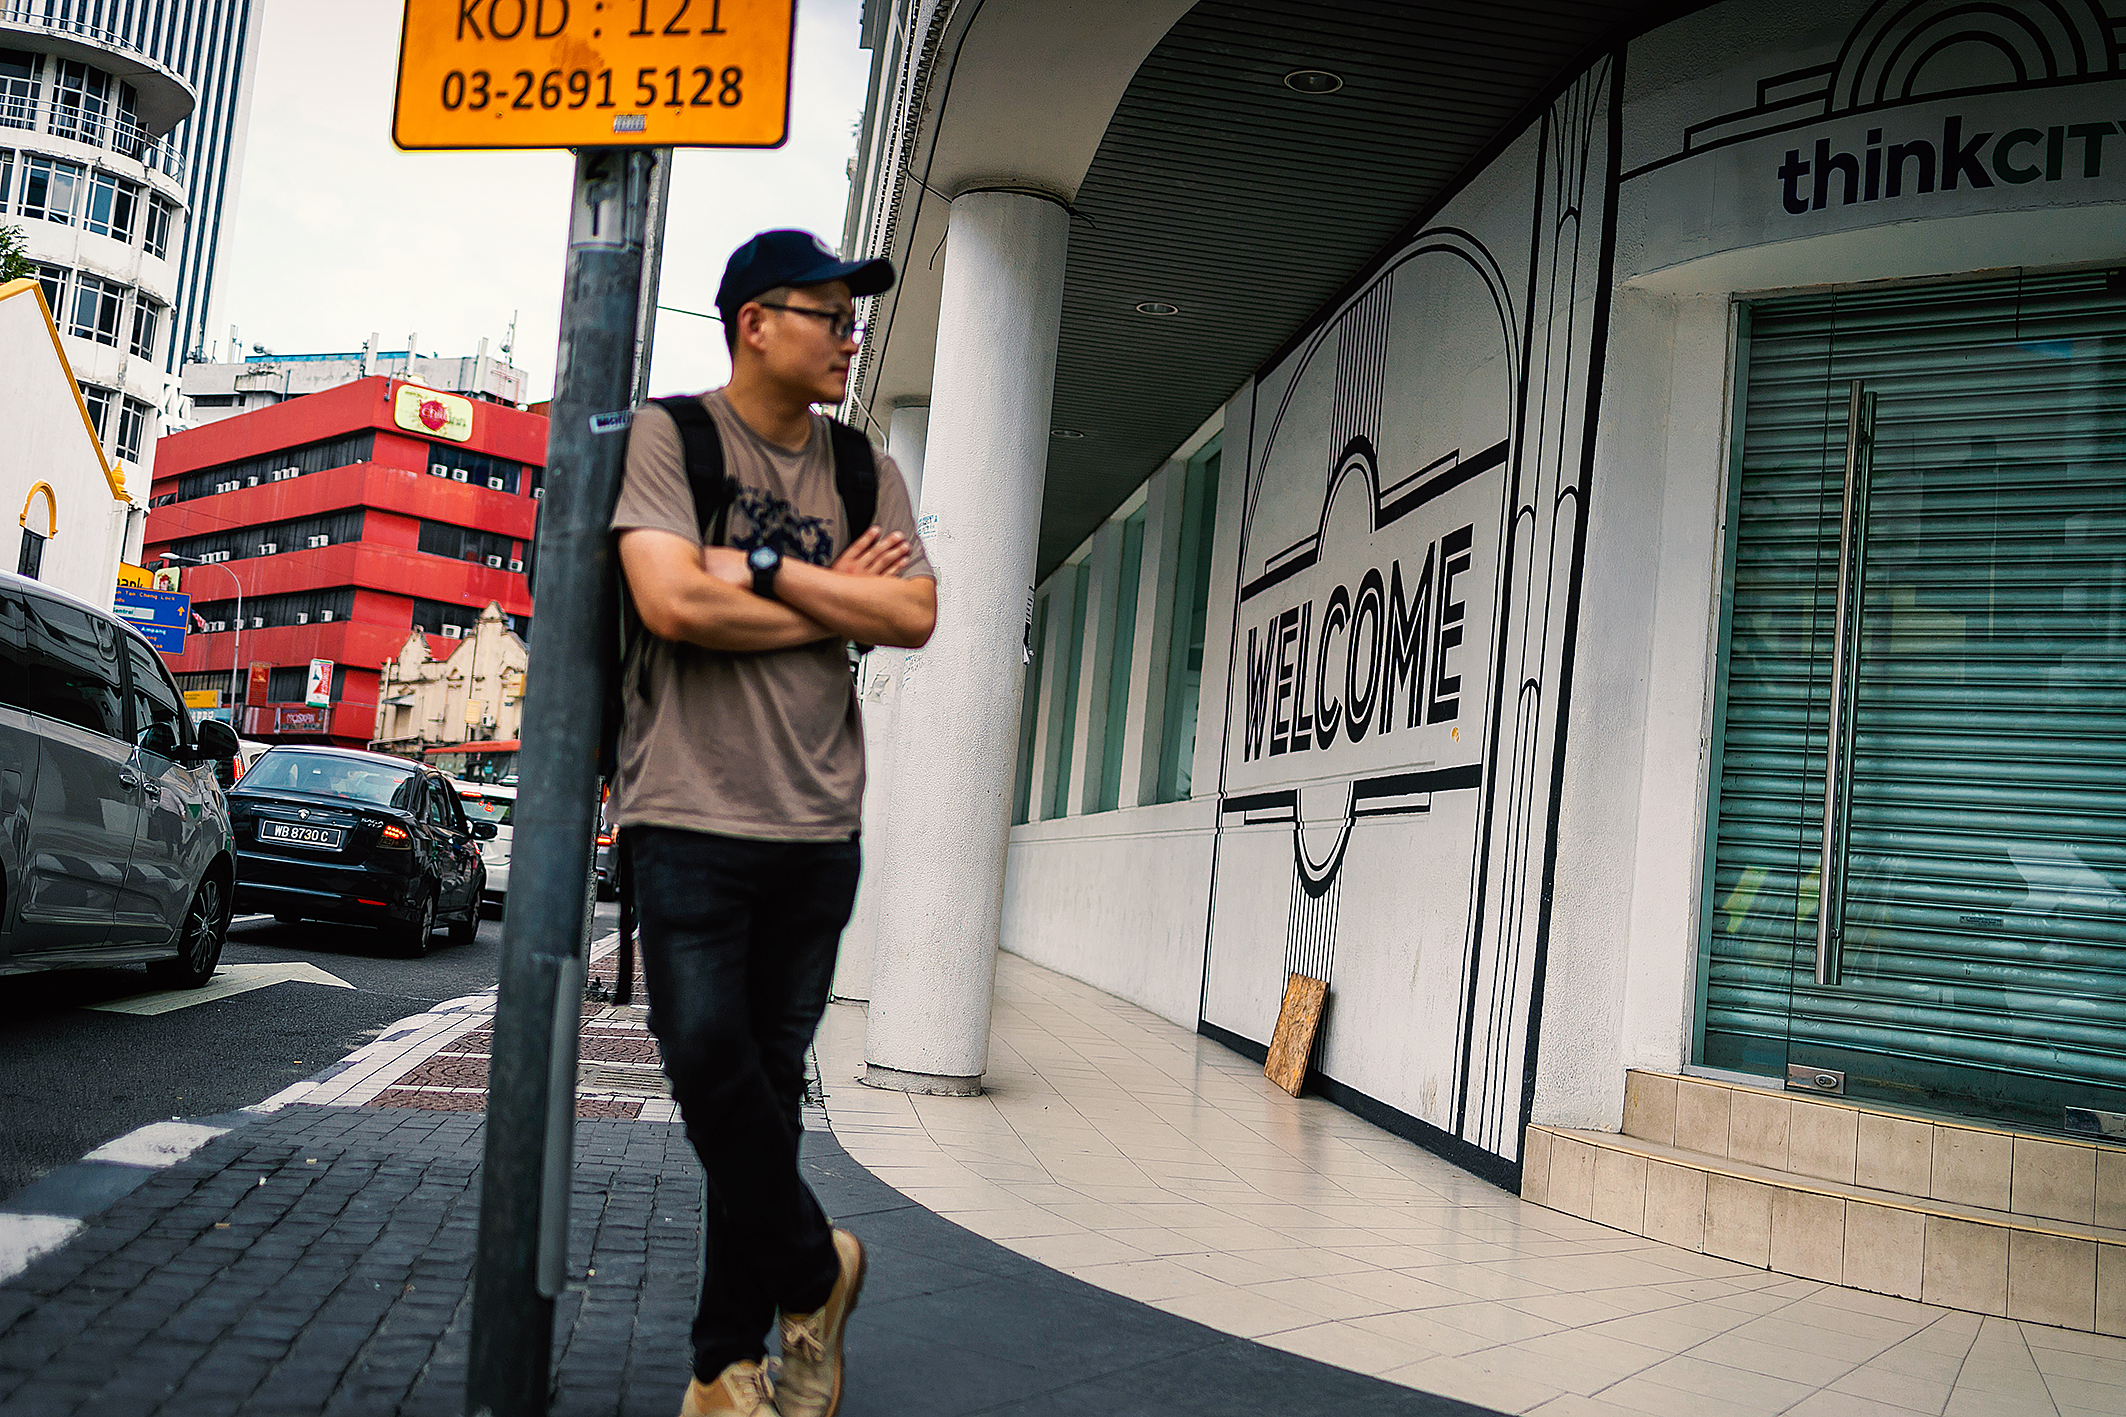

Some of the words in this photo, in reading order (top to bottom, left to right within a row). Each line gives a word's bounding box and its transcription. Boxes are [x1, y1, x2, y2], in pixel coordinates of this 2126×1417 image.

[456, 0, 571, 41] KOD
[629, 0, 728, 38] 121
[441, 68, 617, 111] 03-2691
[634, 65, 744, 108] 5128
[1777, 114, 2126, 216] thinkCIT
[141, 626, 167, 635] Ampang
[1244, 522, 1474, 763] WELCOME
[274, 824, 289, 837] WB
[290, 827, 319, 841] 8730
[320, 831, 329, 842] C
